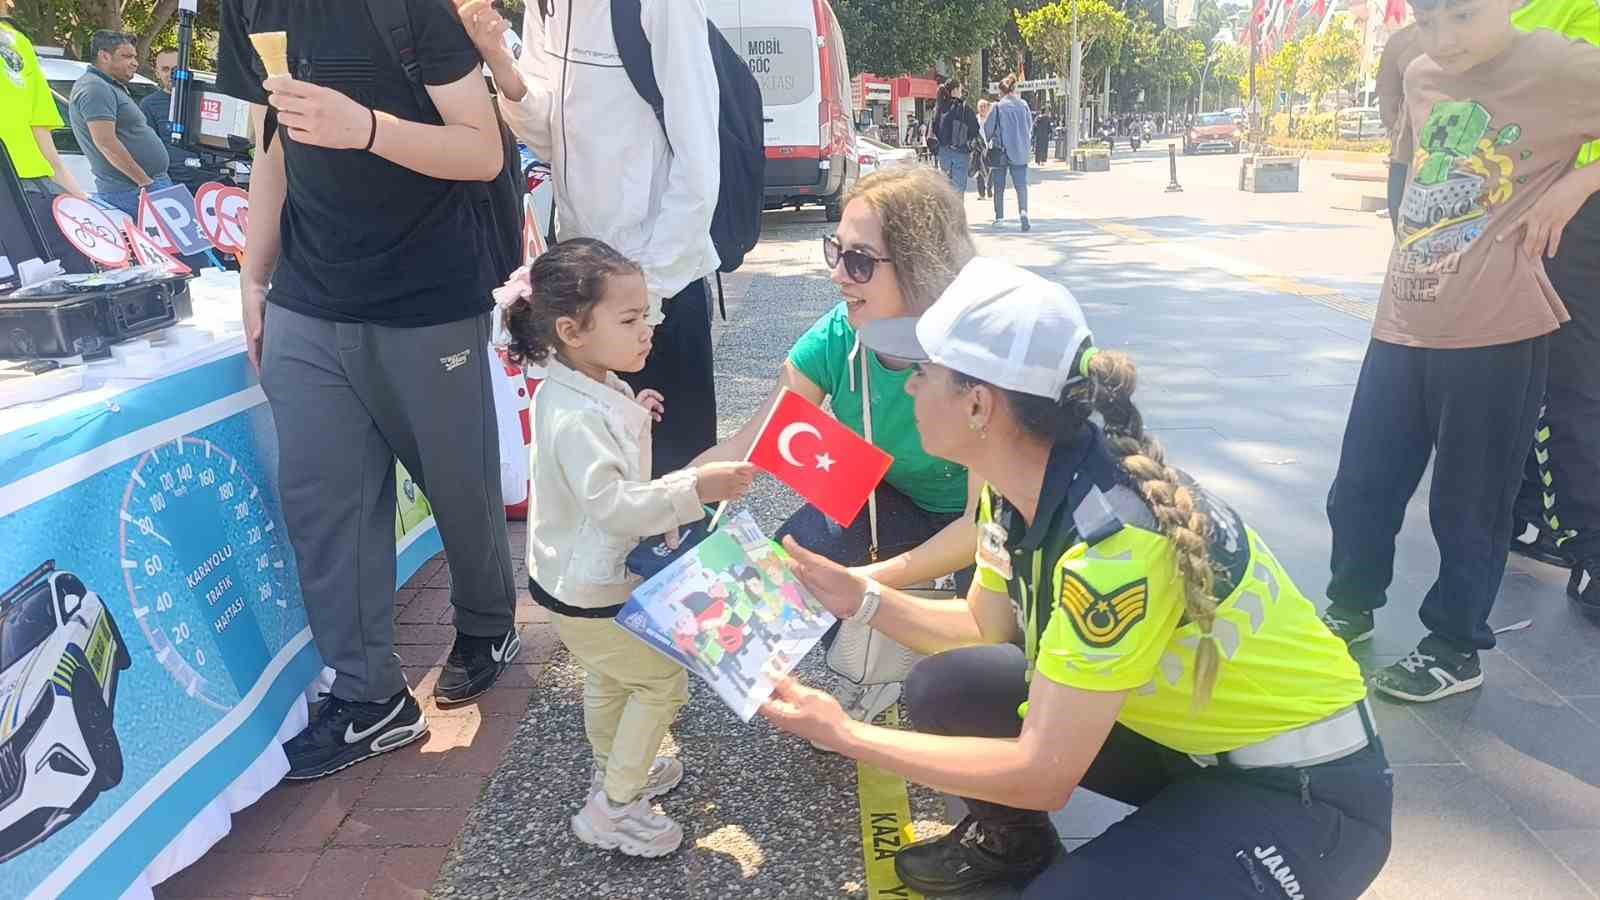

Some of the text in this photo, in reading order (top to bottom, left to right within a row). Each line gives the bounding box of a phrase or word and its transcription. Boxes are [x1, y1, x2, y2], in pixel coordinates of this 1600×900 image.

[748, 37, 784, 56] MOBİL
[749, 56, 770, 74] GÖÇ
[203, 101, 219, 113] 112
[151, 198, 193, 246] P
[160, 471, 175, 492] 120
[176, 463, 193, 483] 140
[199, 467, 215, 487] 160
[218, 482, 234, 500] 180
[150, 491, 166, 512] 100
[234, 502, 249, 520] 200
[138, 516, 154, 535] 80
[247, 526, 262, 545] 220
[144, 554, 162, 577] 60
[185, 544, 232, 588] KARAYOLU
[255, 553, 269, 572] 240
[258, 582, 272, 601] 260
[156, 591, 173, 613] 40
[214, 597, 246, 633] HAFTASI
[172, 622, 190, 644] 20
[195, 649, 206, 666] 0
[870, 812, 910, 900] KAZA Y
